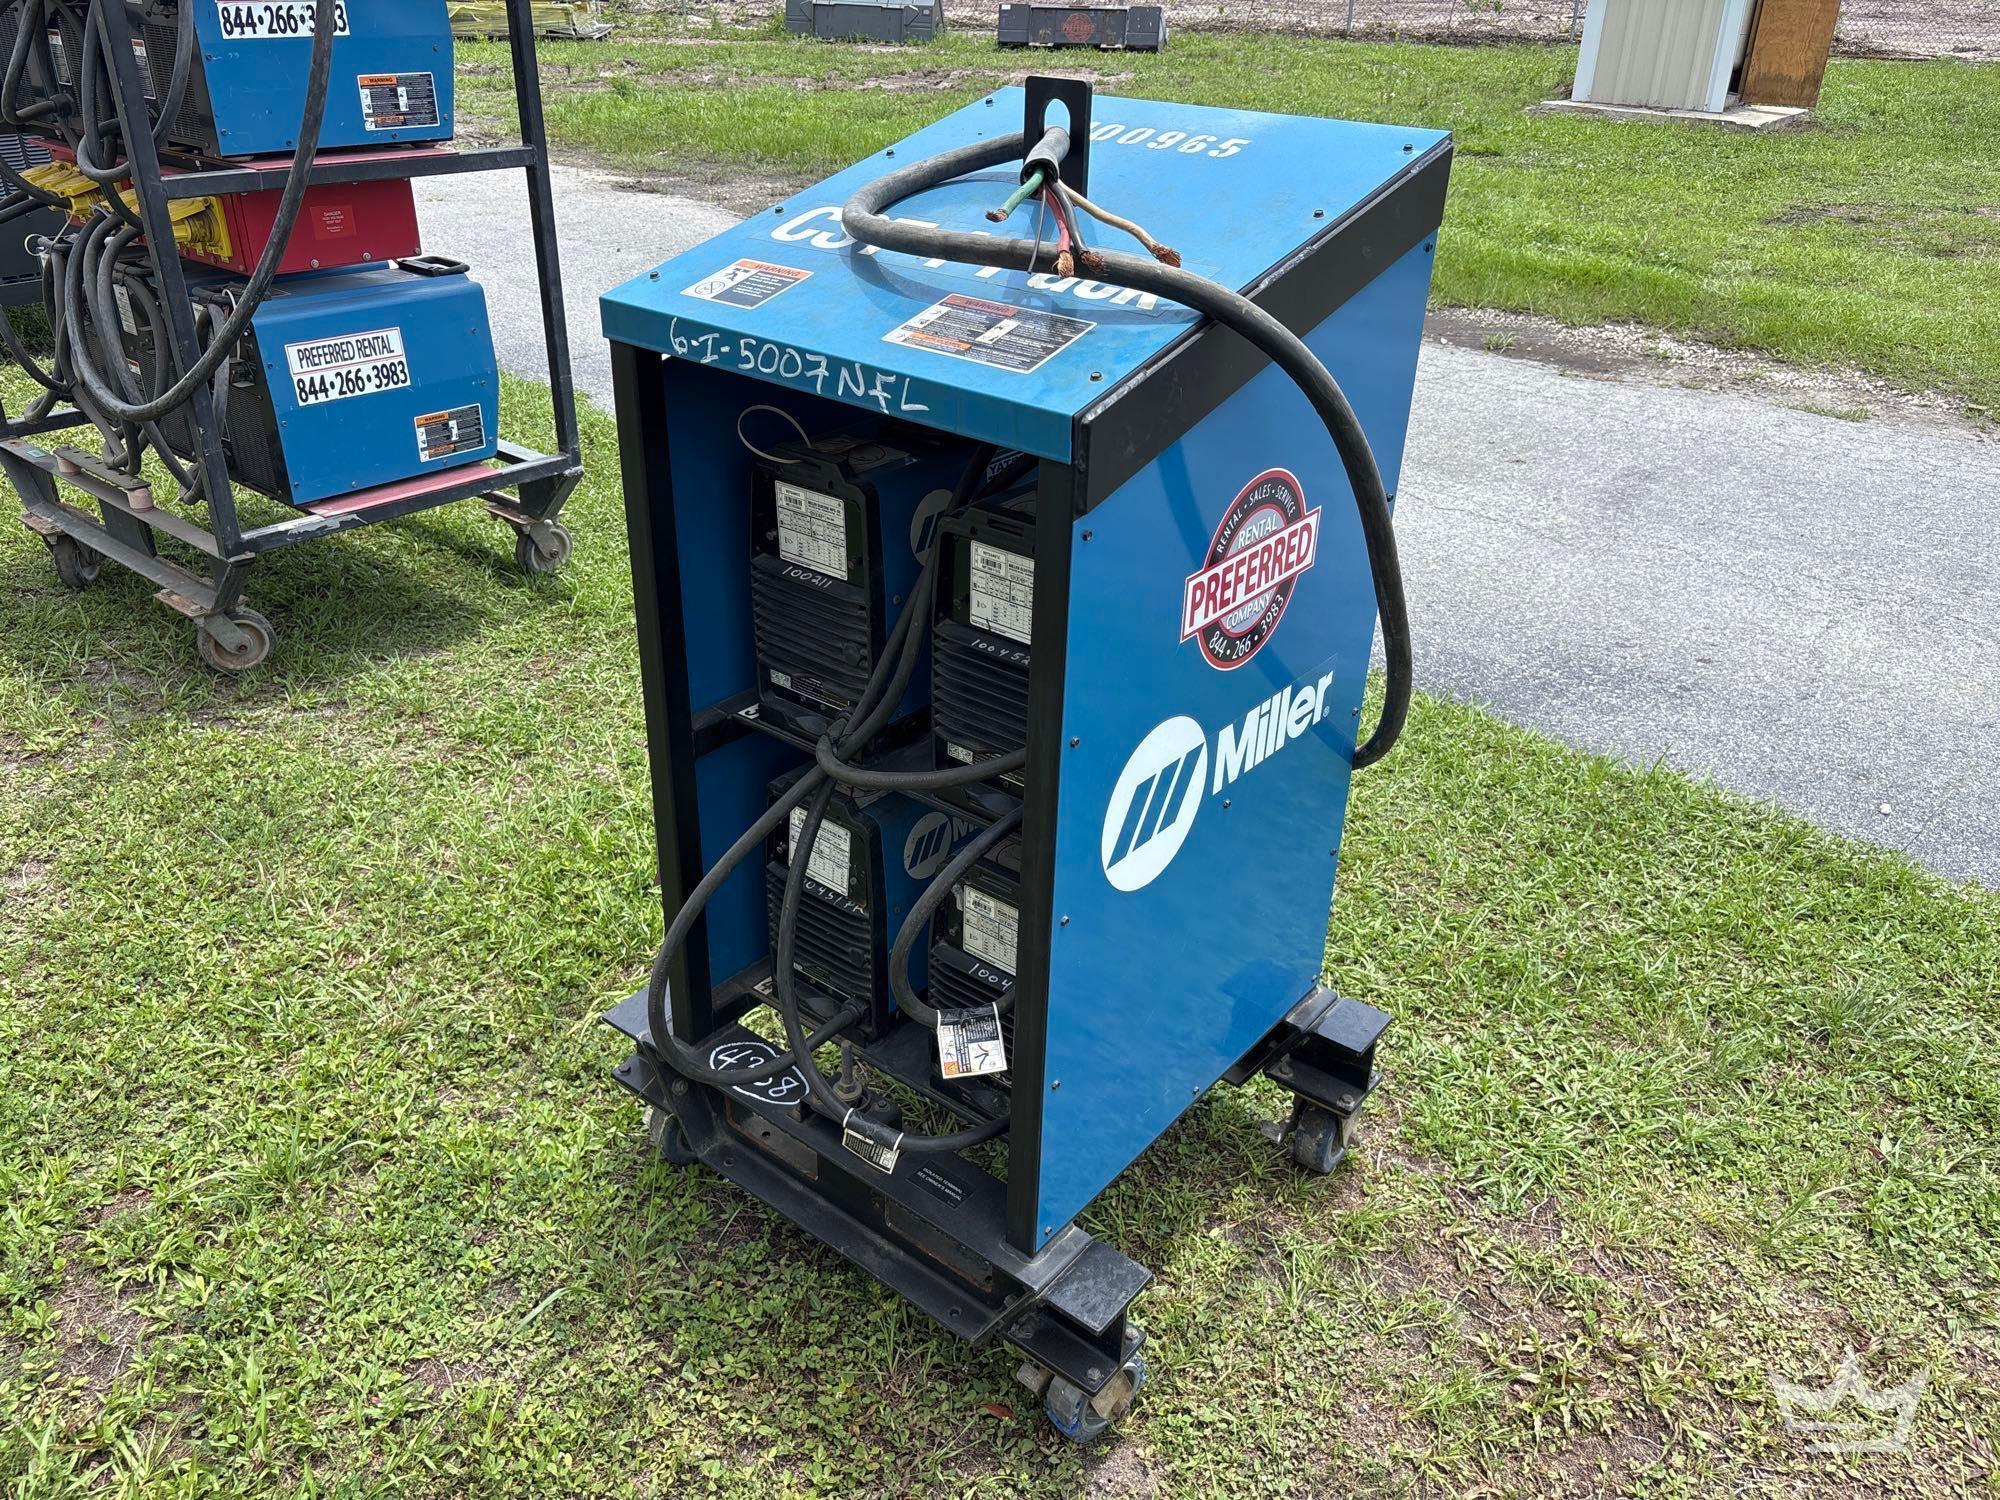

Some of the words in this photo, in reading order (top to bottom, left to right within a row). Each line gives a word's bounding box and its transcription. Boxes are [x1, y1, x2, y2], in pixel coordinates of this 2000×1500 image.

[1089, 121, 1252, 158] 00965
[755, 264, 801, 277] WARNING
[964, 300, 1010, 313] WARNING
[297, 341, 355, 369] PREFERRED
[356, 334, 395, 359] RENTAL
[1216, 508, 1243, 553] RENTAL
[1249, 483, 1271, 505] SALES
[1275, 484, 1297, 517] SERVICE
[1238, 514, 1278, 549] RENTAL
[1188, 522, 1313, 628] PREFERRED
[1226, 593, 1273, 630] COMPANY
